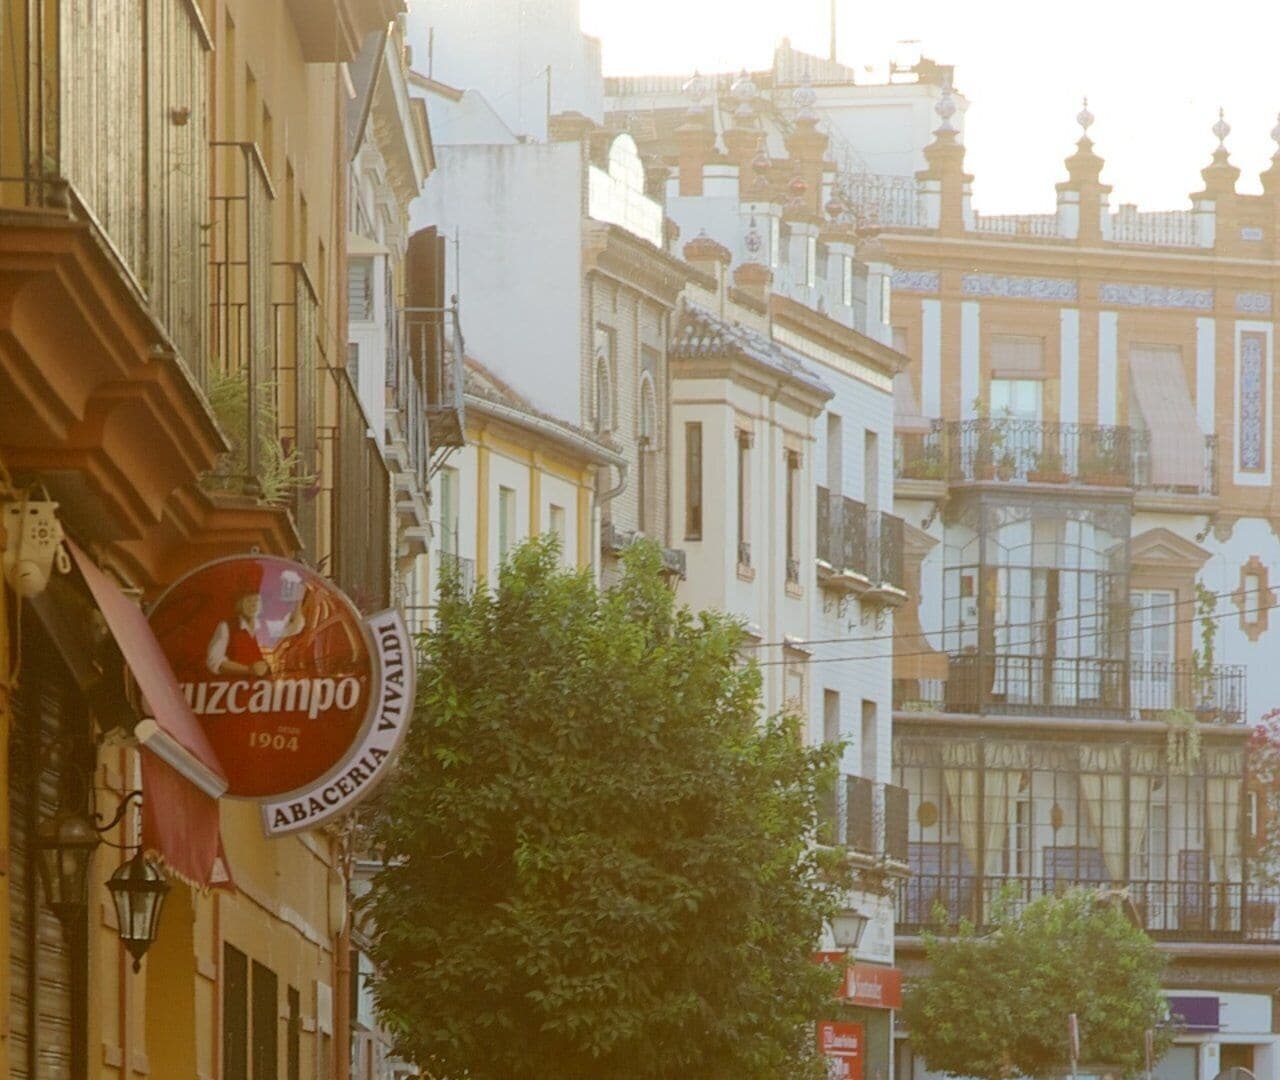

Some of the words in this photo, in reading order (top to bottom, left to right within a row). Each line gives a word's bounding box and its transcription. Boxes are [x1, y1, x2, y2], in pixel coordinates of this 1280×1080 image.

[181, 676, 361, 720] uzcampo
[248, 731, 300, 752] 1904
[272, 747, 389, 829] ABACERIA
[378, 621, 405, 733] VIVALDI
